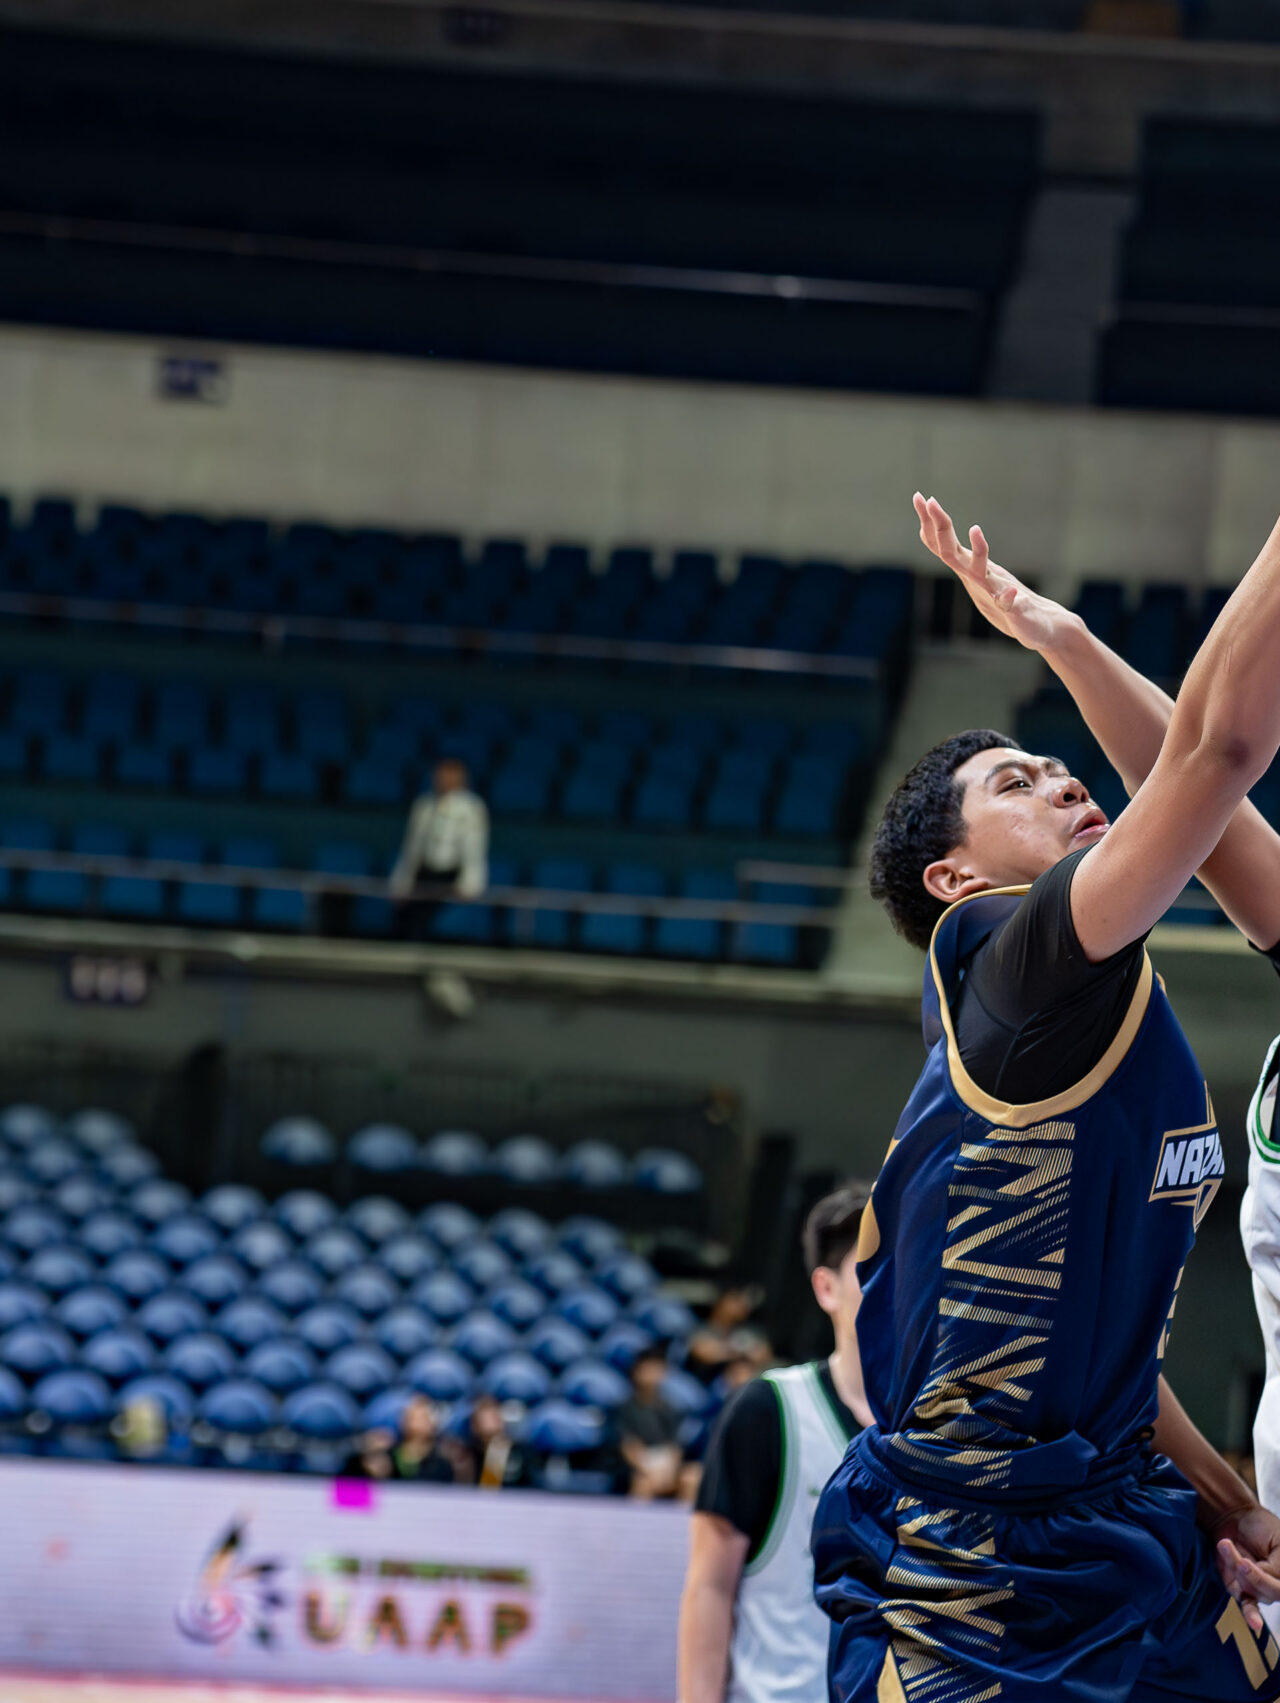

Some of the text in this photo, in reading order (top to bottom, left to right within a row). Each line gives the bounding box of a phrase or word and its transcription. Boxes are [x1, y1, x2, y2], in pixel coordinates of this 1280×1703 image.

[1155, 1131, 1226, 1189] NAZA
[304, 1588, 531, 1657] UAAP
[1215, 1595, 1280, 1691] 1
